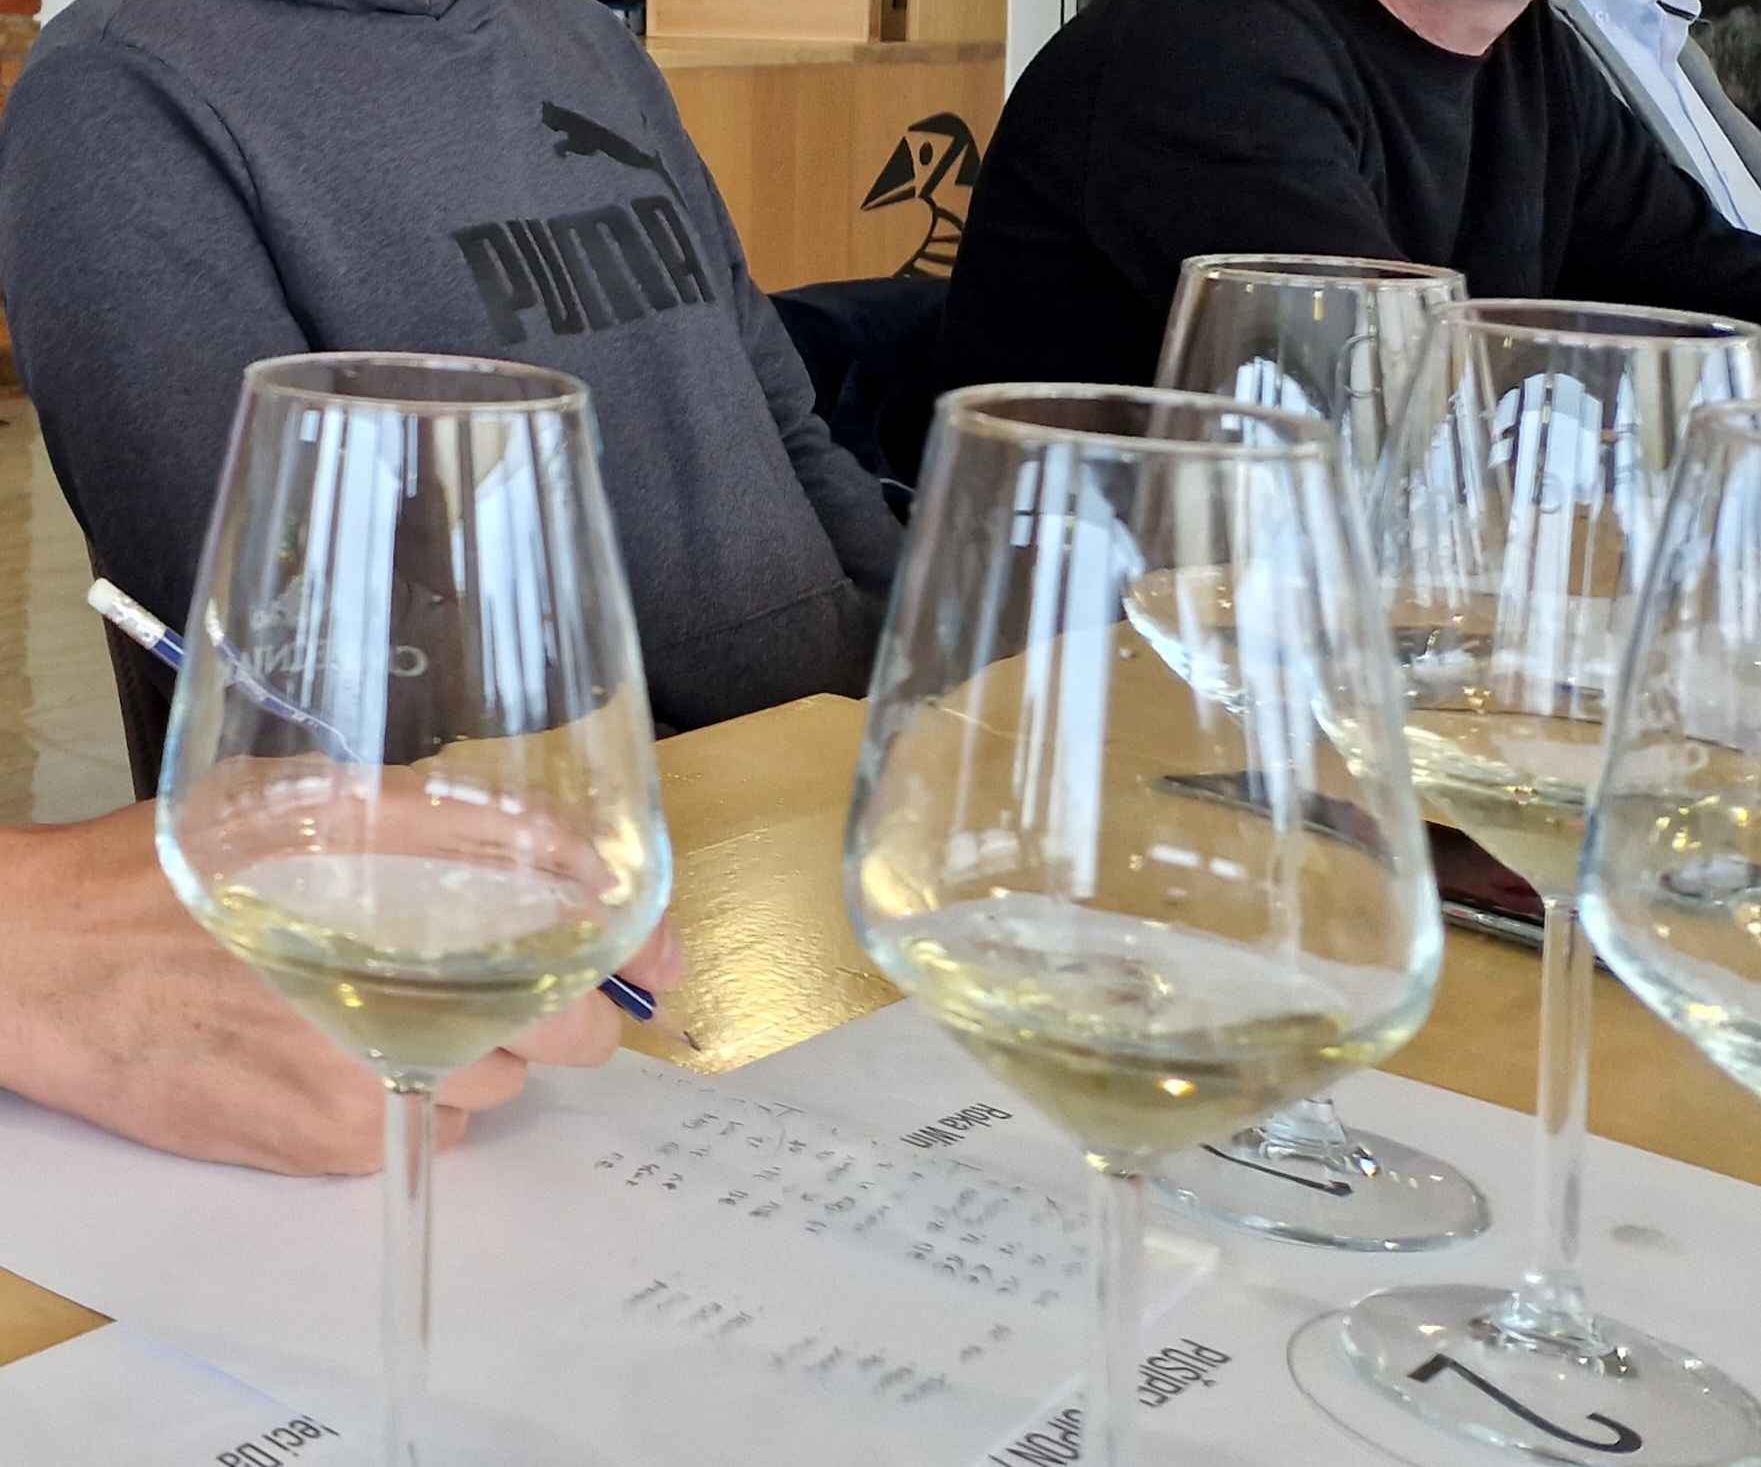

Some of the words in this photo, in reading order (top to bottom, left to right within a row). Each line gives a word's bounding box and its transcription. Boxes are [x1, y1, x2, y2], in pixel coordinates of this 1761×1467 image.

[451, 194, 717, 346] PUMA
[937, 1101, 1014, 1131] Roka
[1406, 1351, 1644, 1456] 2
